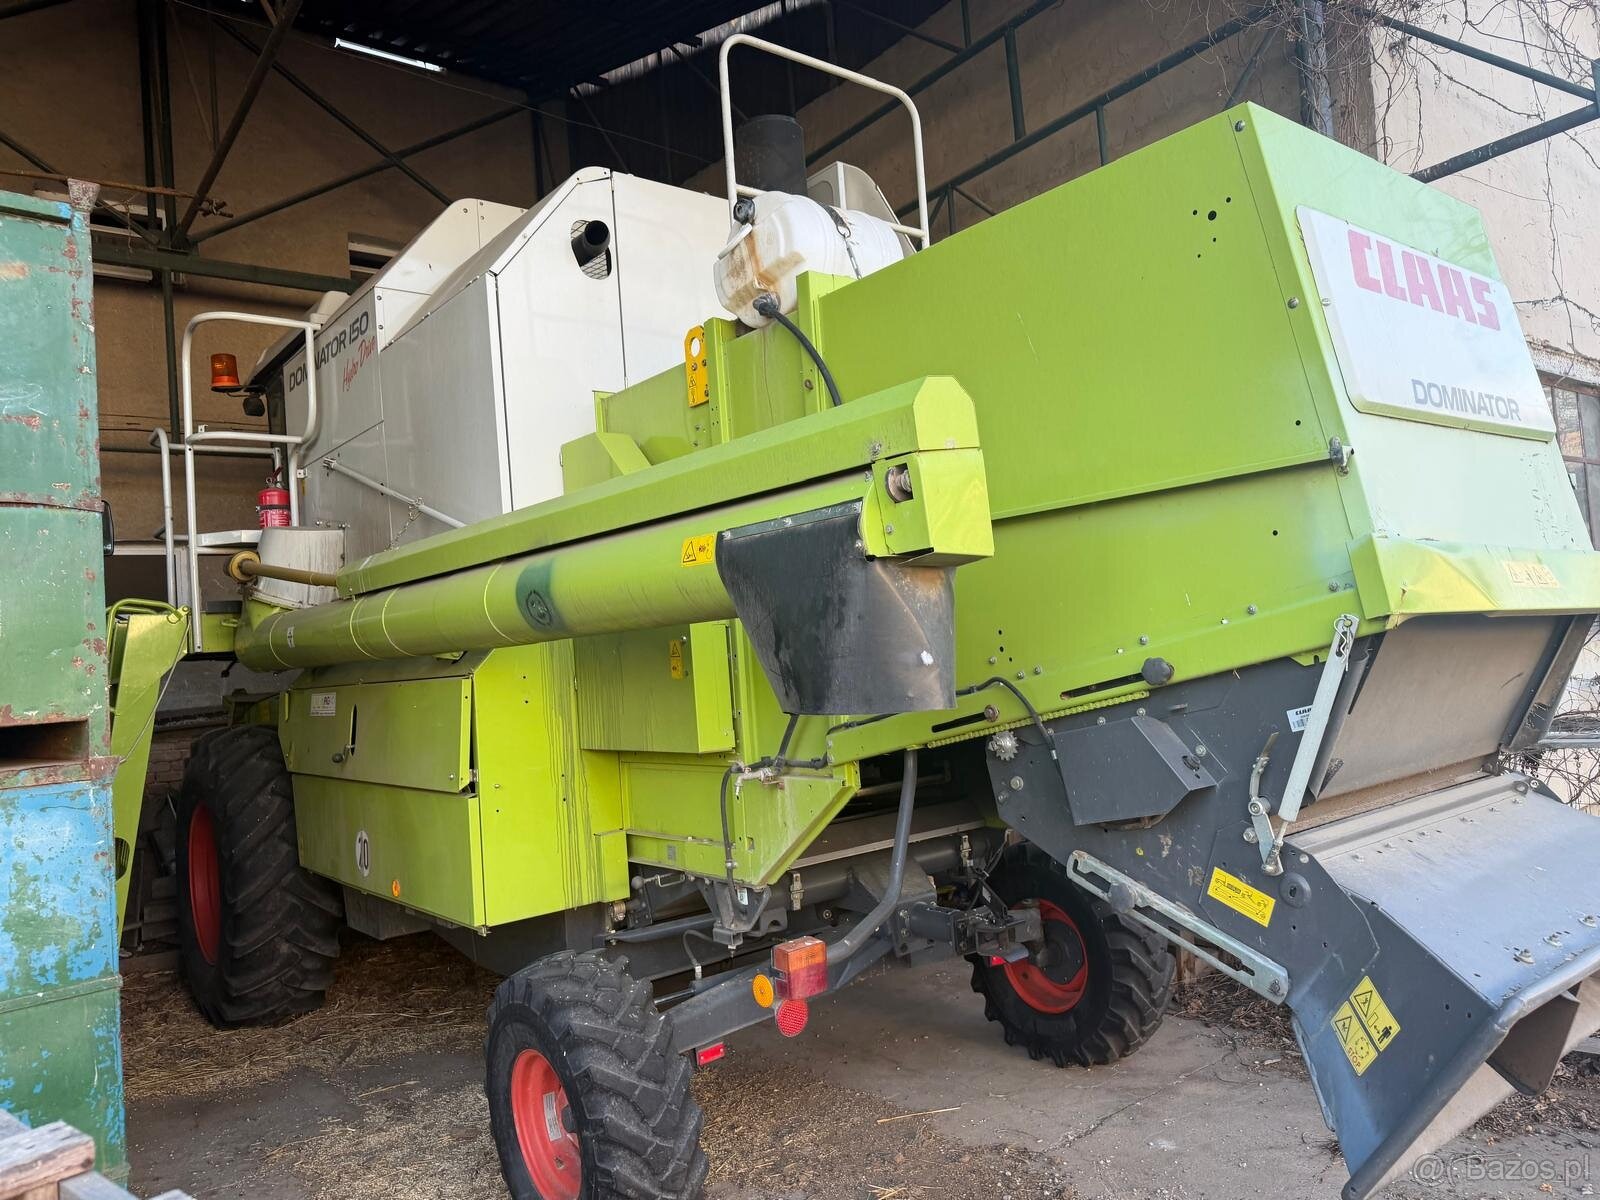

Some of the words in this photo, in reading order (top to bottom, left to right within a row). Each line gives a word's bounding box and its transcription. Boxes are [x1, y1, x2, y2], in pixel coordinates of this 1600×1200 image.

[1347, 229, 1500, 331] CLAAS
[349, 311, 369, 345] 150
[1411, 378, 1522, 421] DOMINATOR
[1347, 1046, 1362, 1068] STOP
